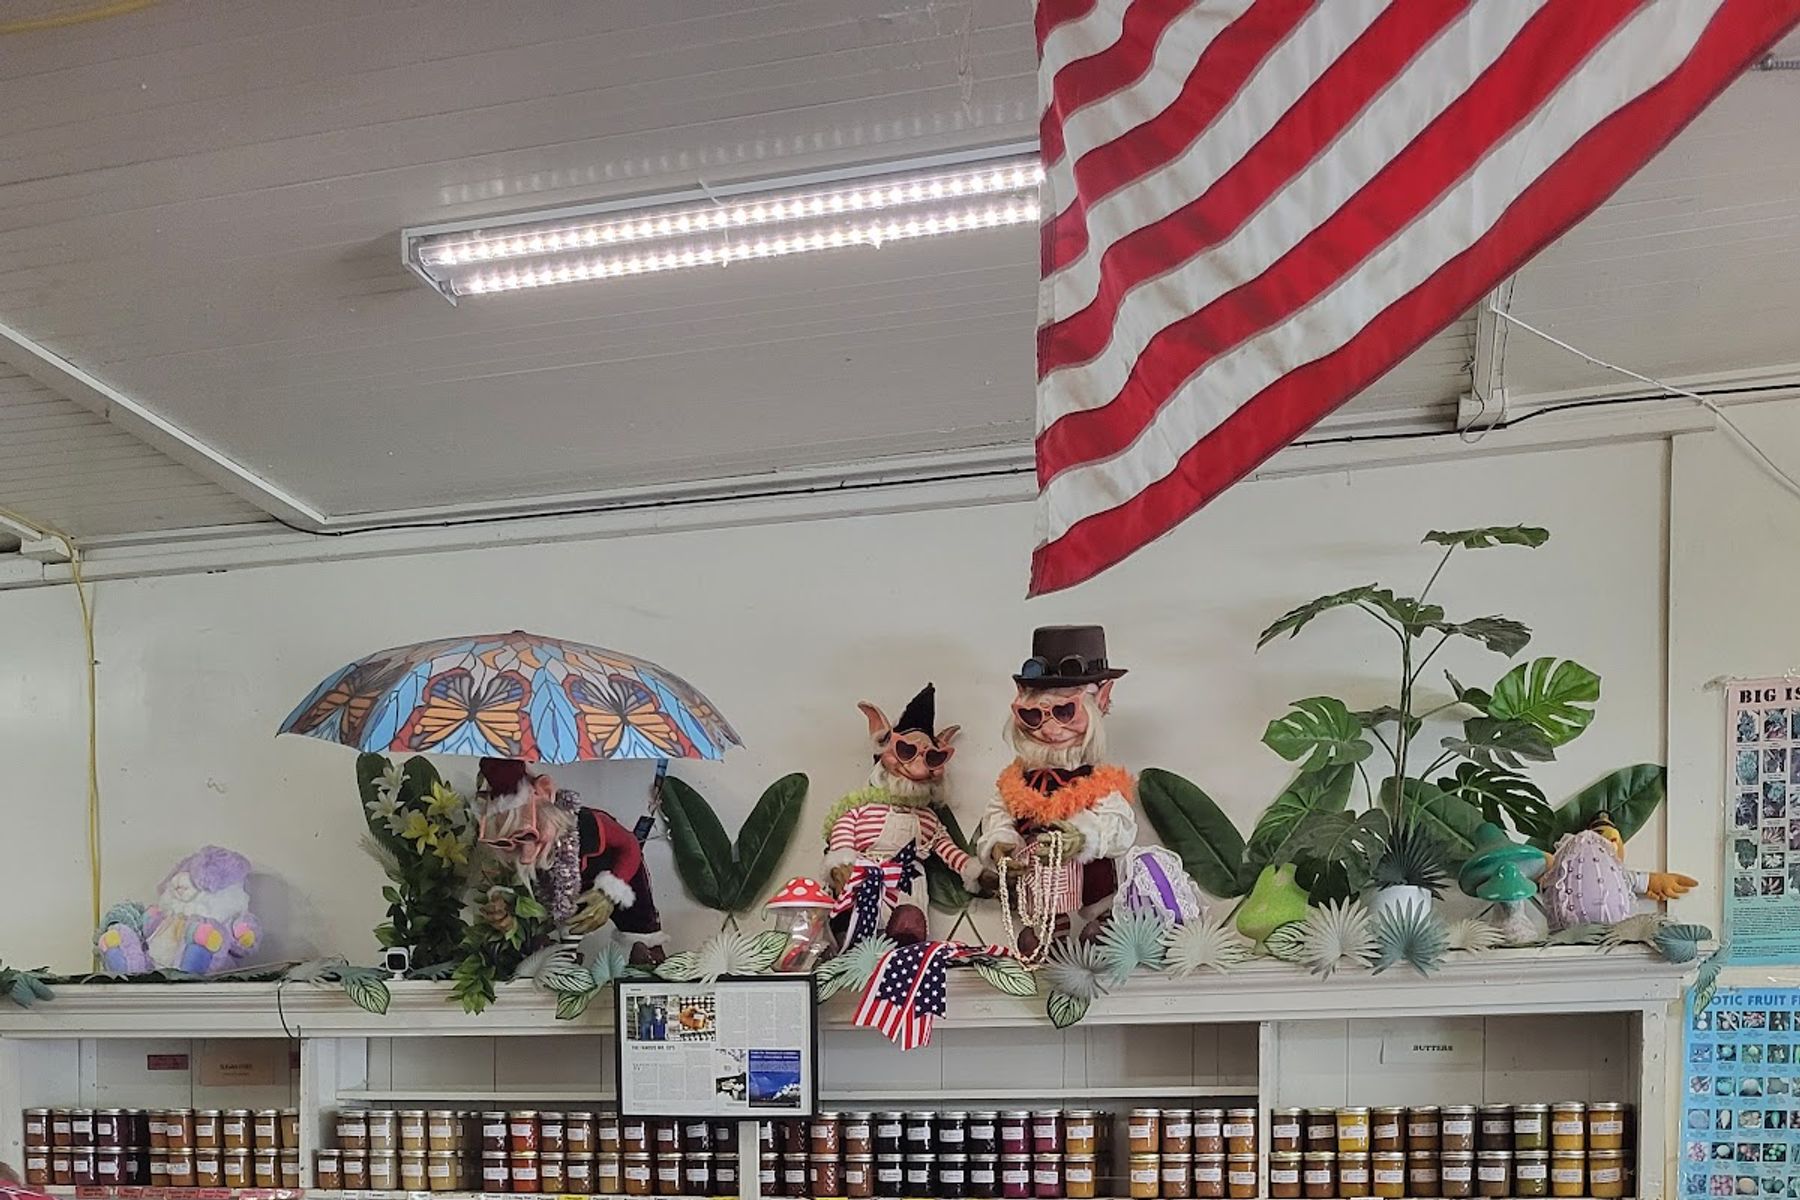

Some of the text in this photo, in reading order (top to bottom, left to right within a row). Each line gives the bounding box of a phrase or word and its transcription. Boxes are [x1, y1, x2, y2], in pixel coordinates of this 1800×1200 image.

[1739, 688, 1776, 703] BIG
[1712, 994, 1743, 1006] OTIC
[1747, 994, 1786, 1006] FRUIT
